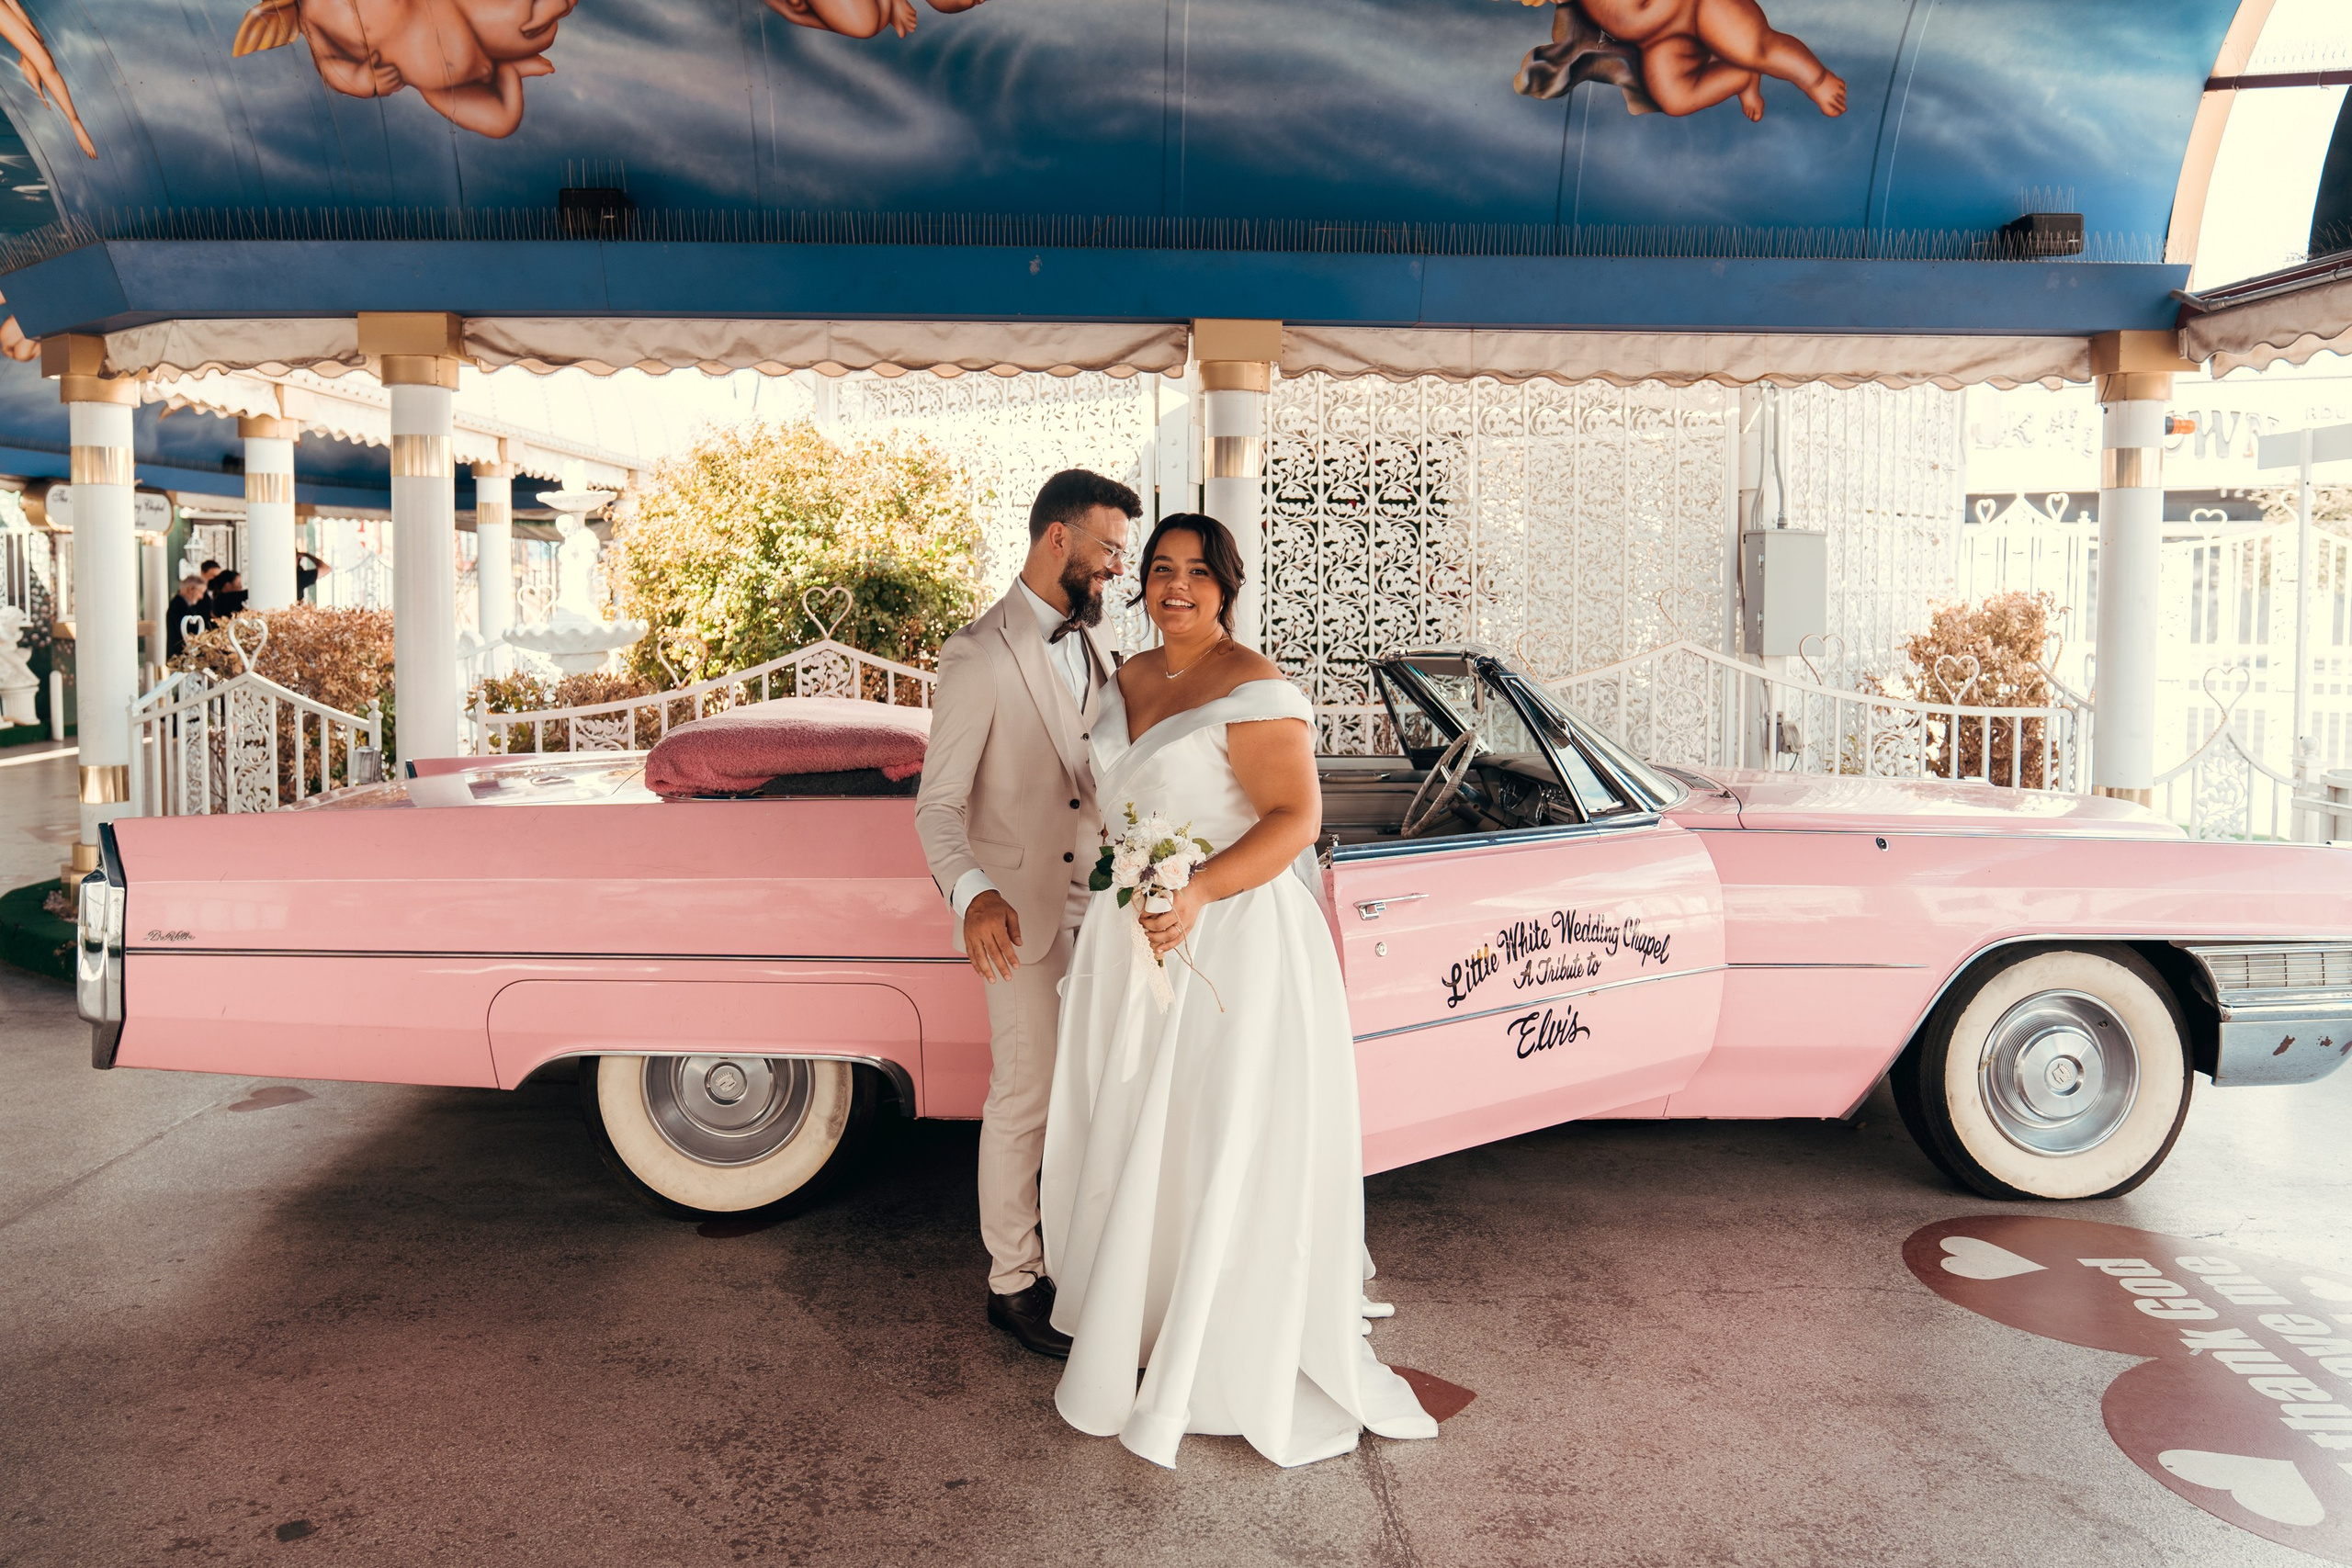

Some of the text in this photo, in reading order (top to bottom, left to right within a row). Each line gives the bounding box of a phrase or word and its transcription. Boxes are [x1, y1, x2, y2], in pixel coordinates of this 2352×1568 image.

[1442, 908, 1670, 1009] Little White Wedding Chapel
[1512, 951, 1602, 989] A Tribute to
[2076, 1257, 2219, 1321] God
[2175, 1255, 2294, 1305] me
